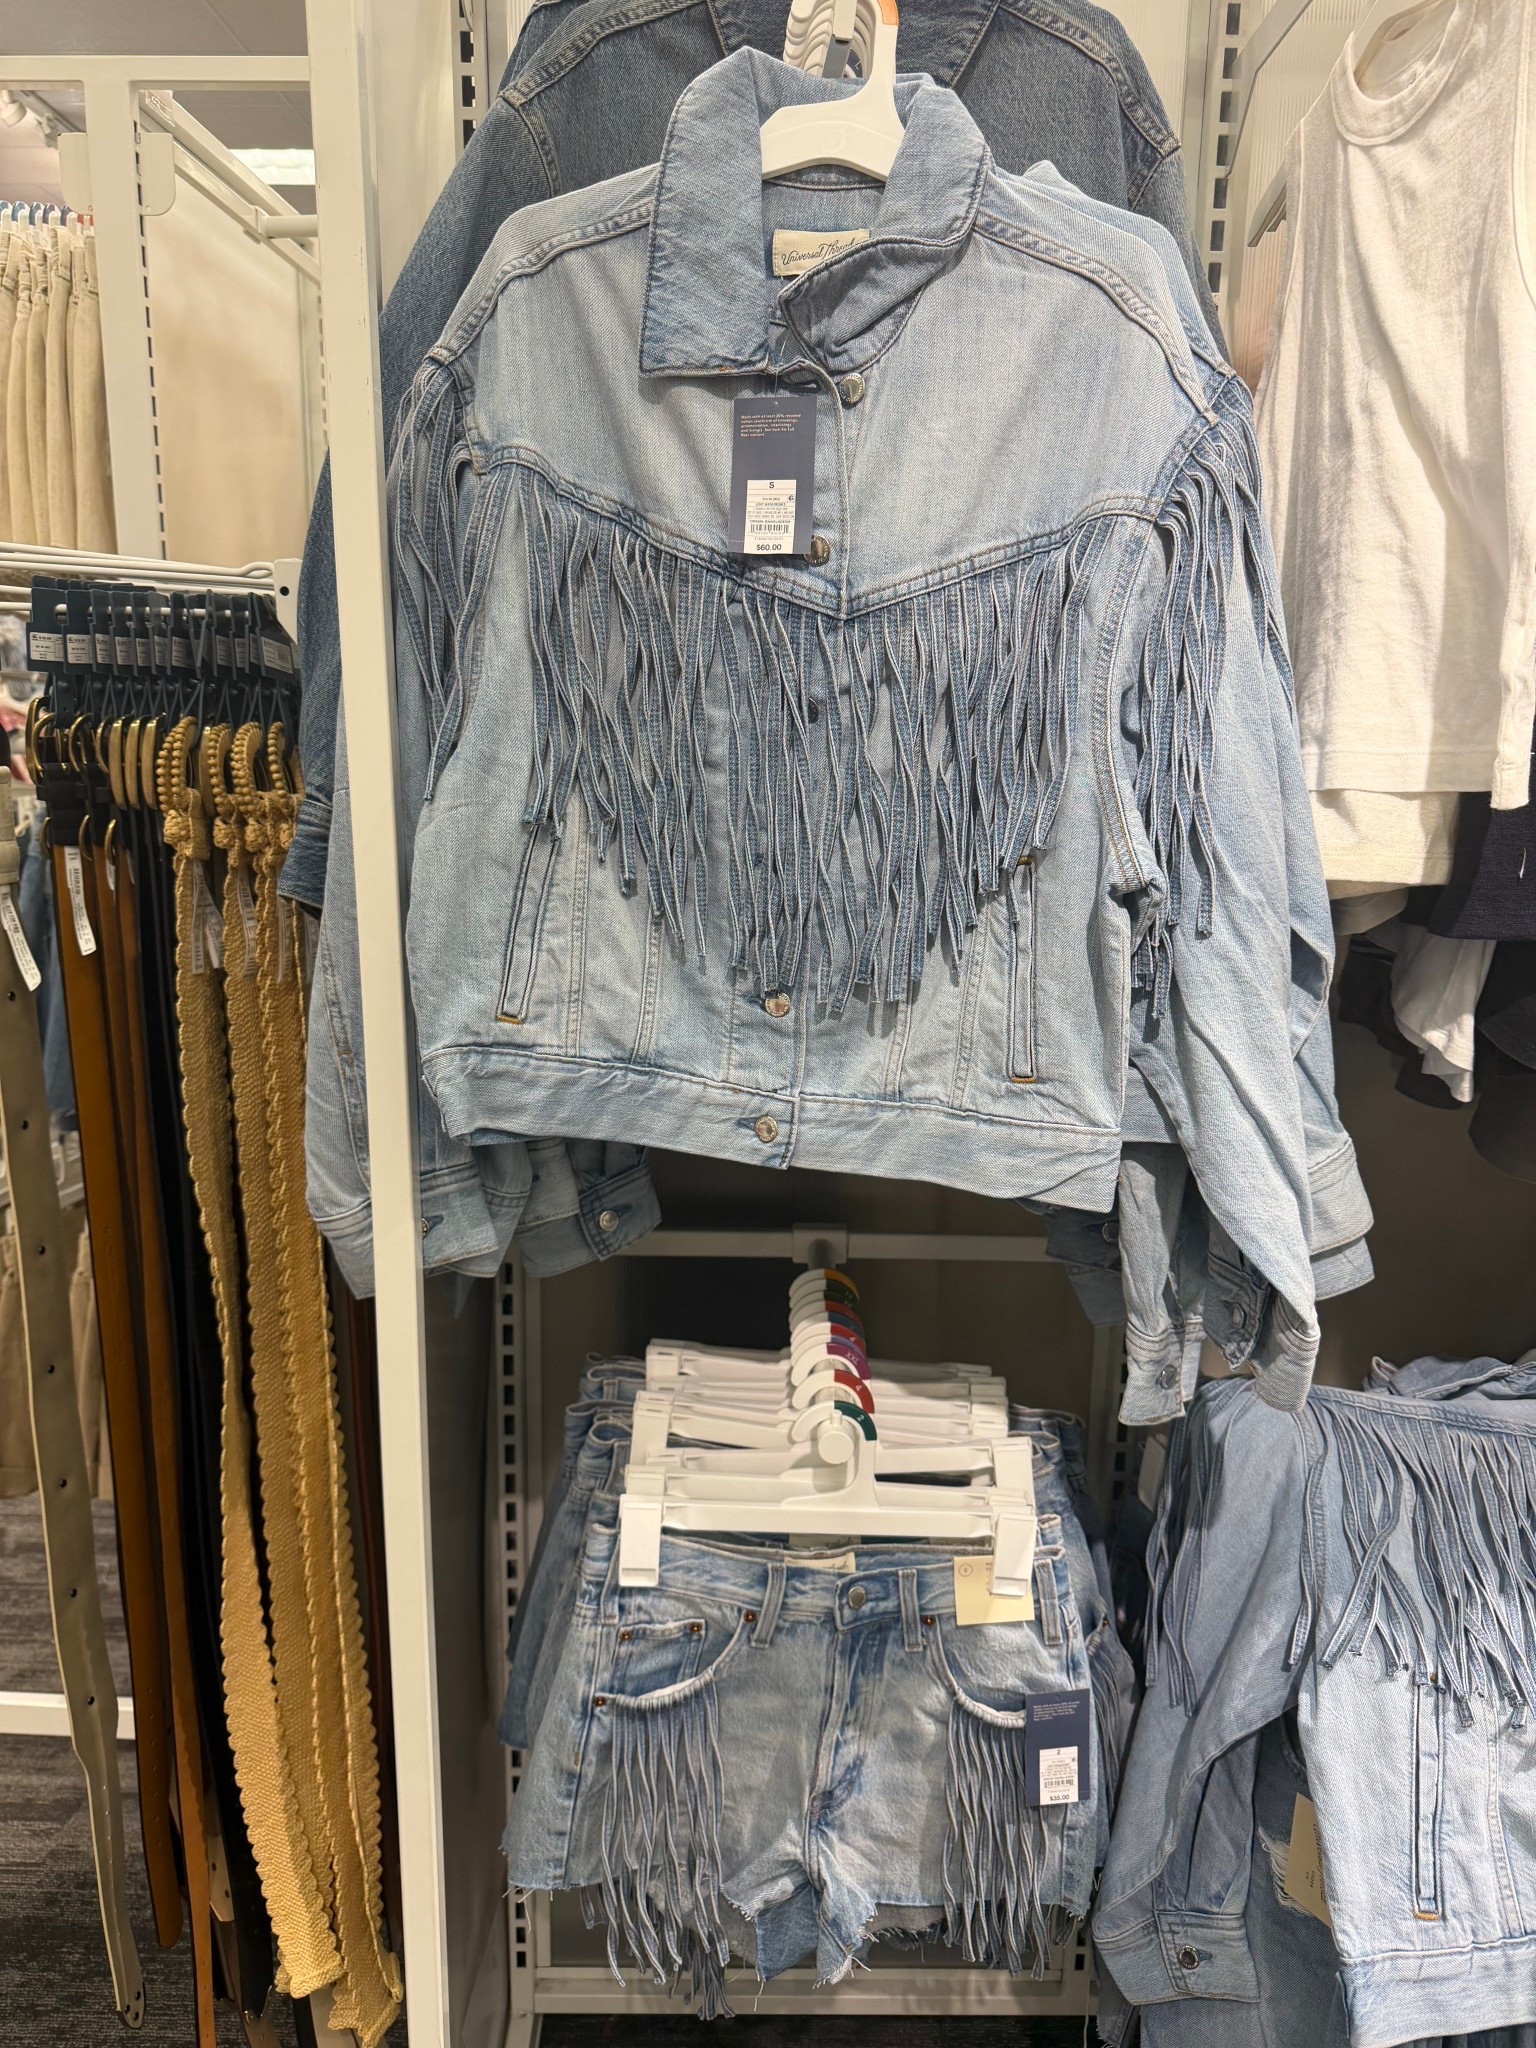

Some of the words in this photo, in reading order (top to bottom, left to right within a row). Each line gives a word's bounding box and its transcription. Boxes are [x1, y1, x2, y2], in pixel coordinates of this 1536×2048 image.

[781, 246, 823, 265] Universal
[769, 481, 775, 489] S
[756, 543, 782, 551] $60.00
[845, 1352, 859, 1366] XXL
[856, 1414, 864, 1422] 2
